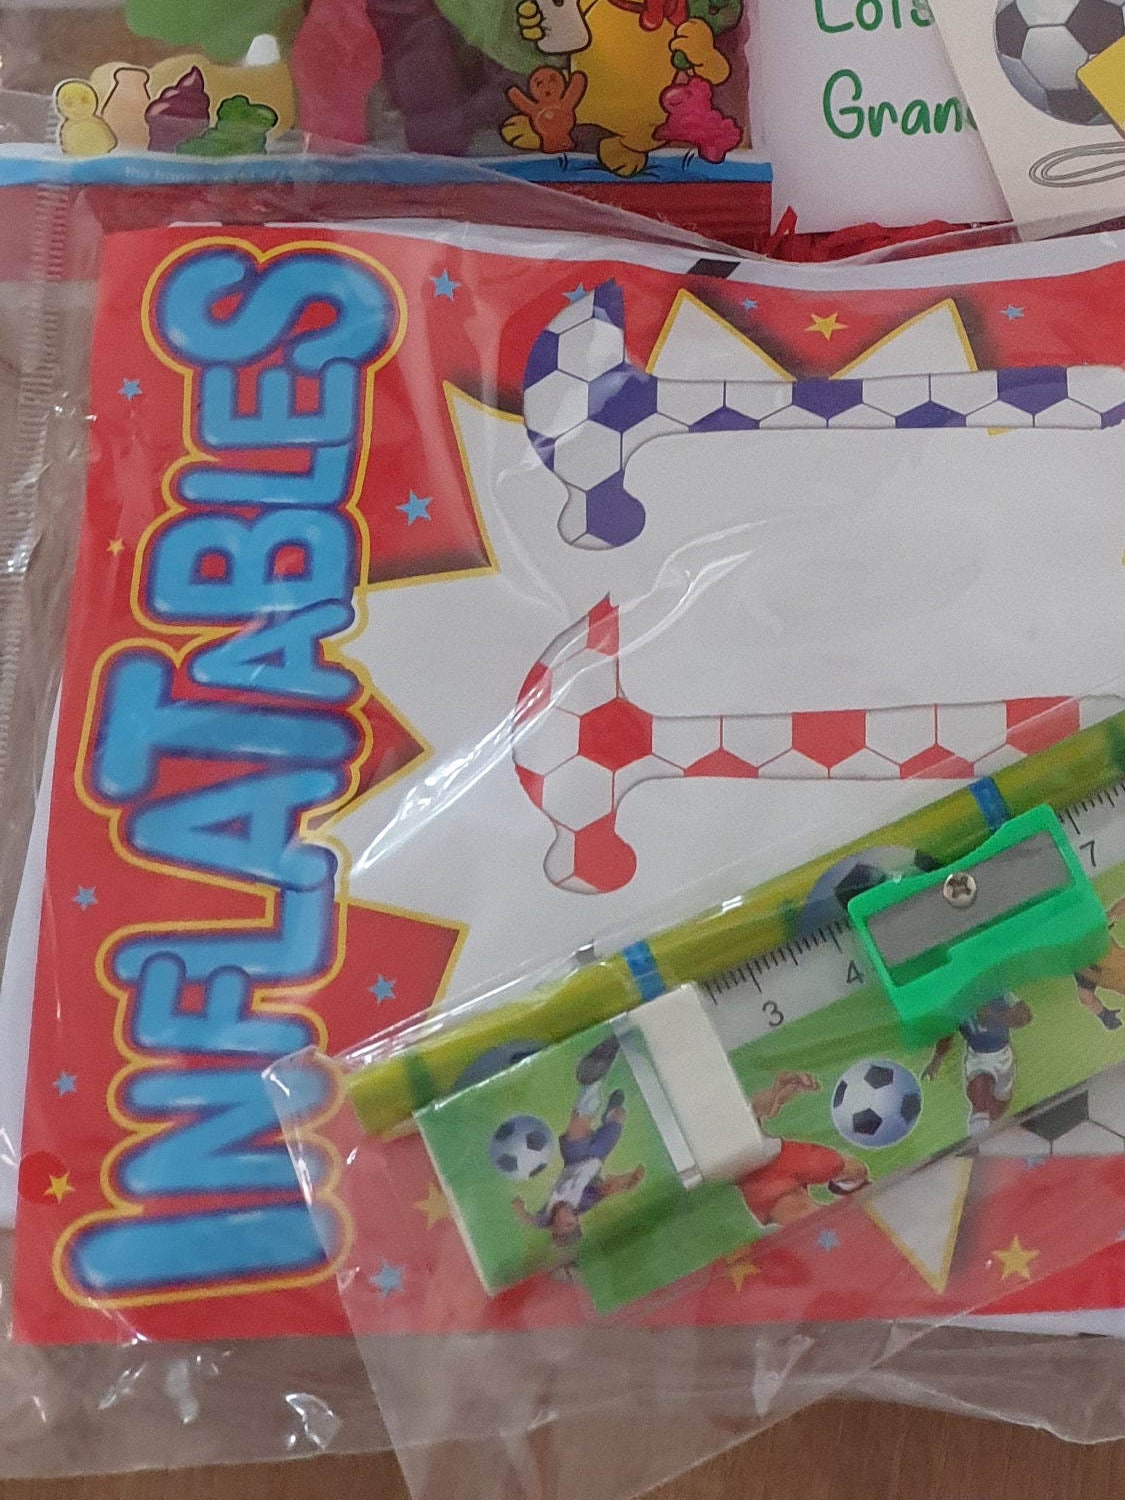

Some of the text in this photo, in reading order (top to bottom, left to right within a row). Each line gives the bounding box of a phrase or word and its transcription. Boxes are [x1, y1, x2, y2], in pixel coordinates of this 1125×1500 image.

[60, 242, 400, 1300] INFLATABLES
[762, 1001, 784, 1027] 3
[846, 960, 864, 984] 4
[1079, 840, 1096, 867] 7
